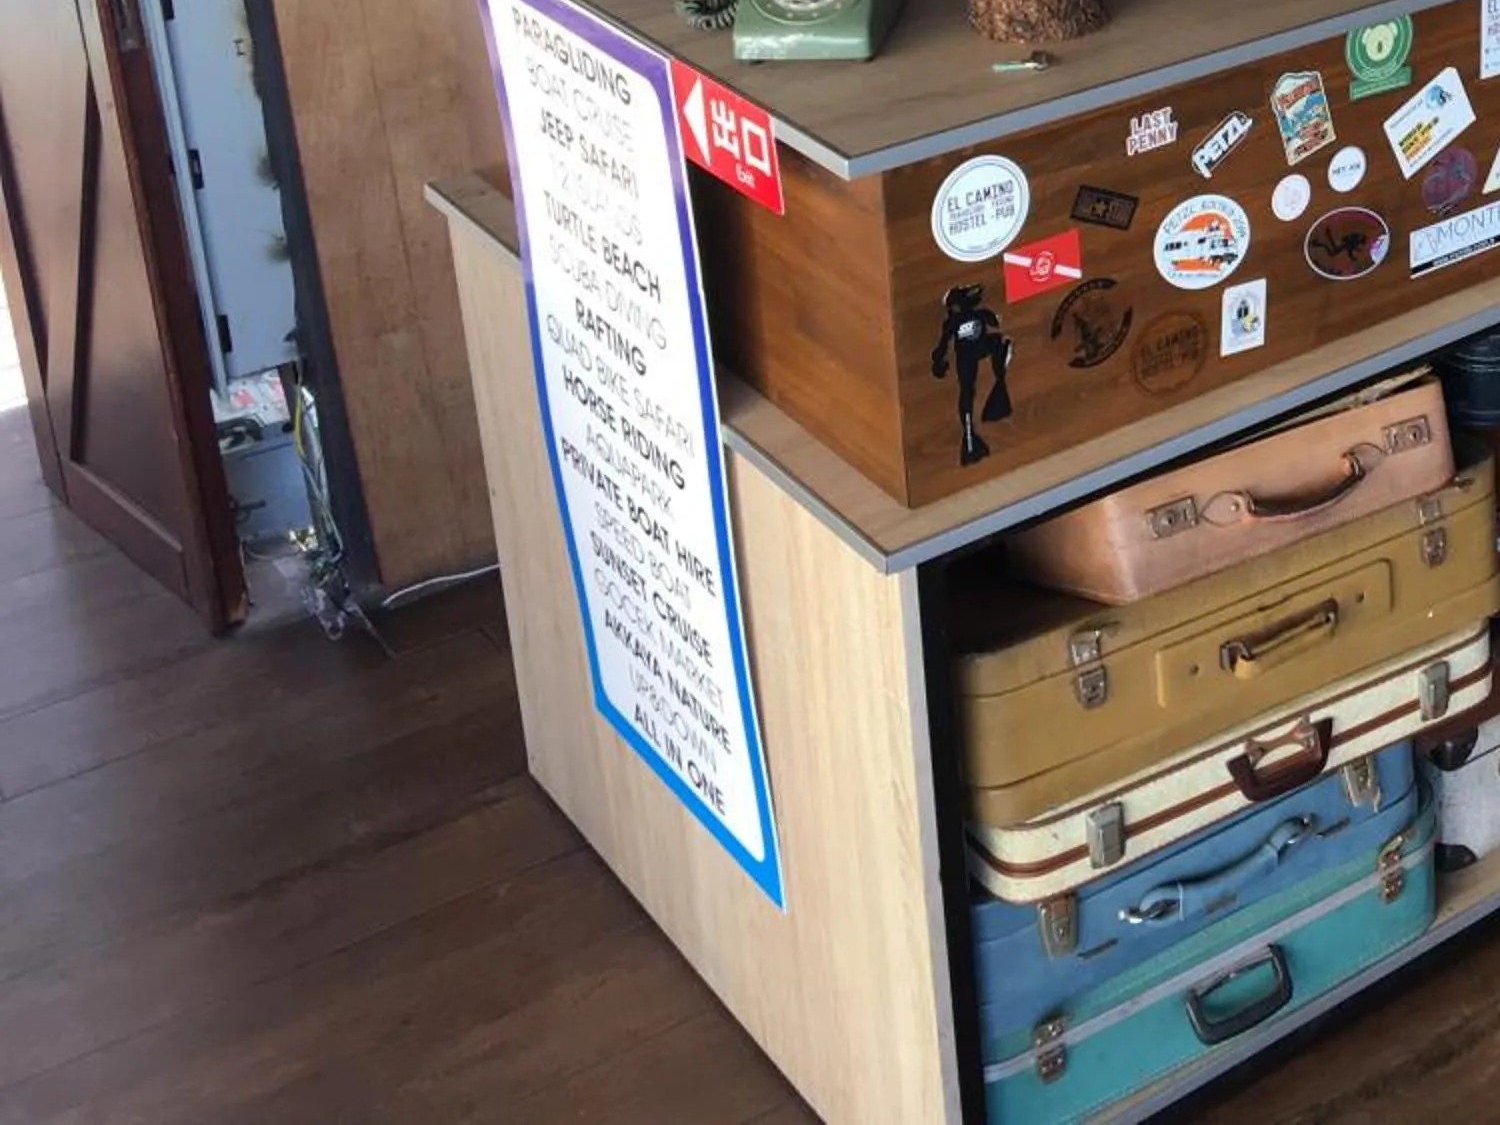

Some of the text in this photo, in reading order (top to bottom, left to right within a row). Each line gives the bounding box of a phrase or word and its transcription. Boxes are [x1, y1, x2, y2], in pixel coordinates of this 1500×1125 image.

[512, 7, 631, 105] PARAGLIDING
[540, 107, 638, 197] JEEP SAFARI
[710, 98, 772, 178] 出口
[1126, 122, 1179, 156] PENNY
[1130, 106, 1174, 136] LAST
[947, 197, 961, 213] EL
[966, 178, 1014, 208] CAMINO
[949, 213, 988, 236] HOSTEL
[543, 189, 661, 303] TURTLE BEACH
[545, 313, 592, 371] QUAD
[595, 355, 629, 406] BIKE
[574, 297, 646, 376] RAFTING
[561, 364, 685, 490] HORSE RIDING
[560, 435, 716, 597] PRIVATE BOAT HIRE
[594, 501, 691, 609] SPEED BOAT
[589, 530, 712, 667] SUNSET CRUISE
[666, 670, 731, 754] NATURE
[633, 702, 725, 815] ALL IN ONE
